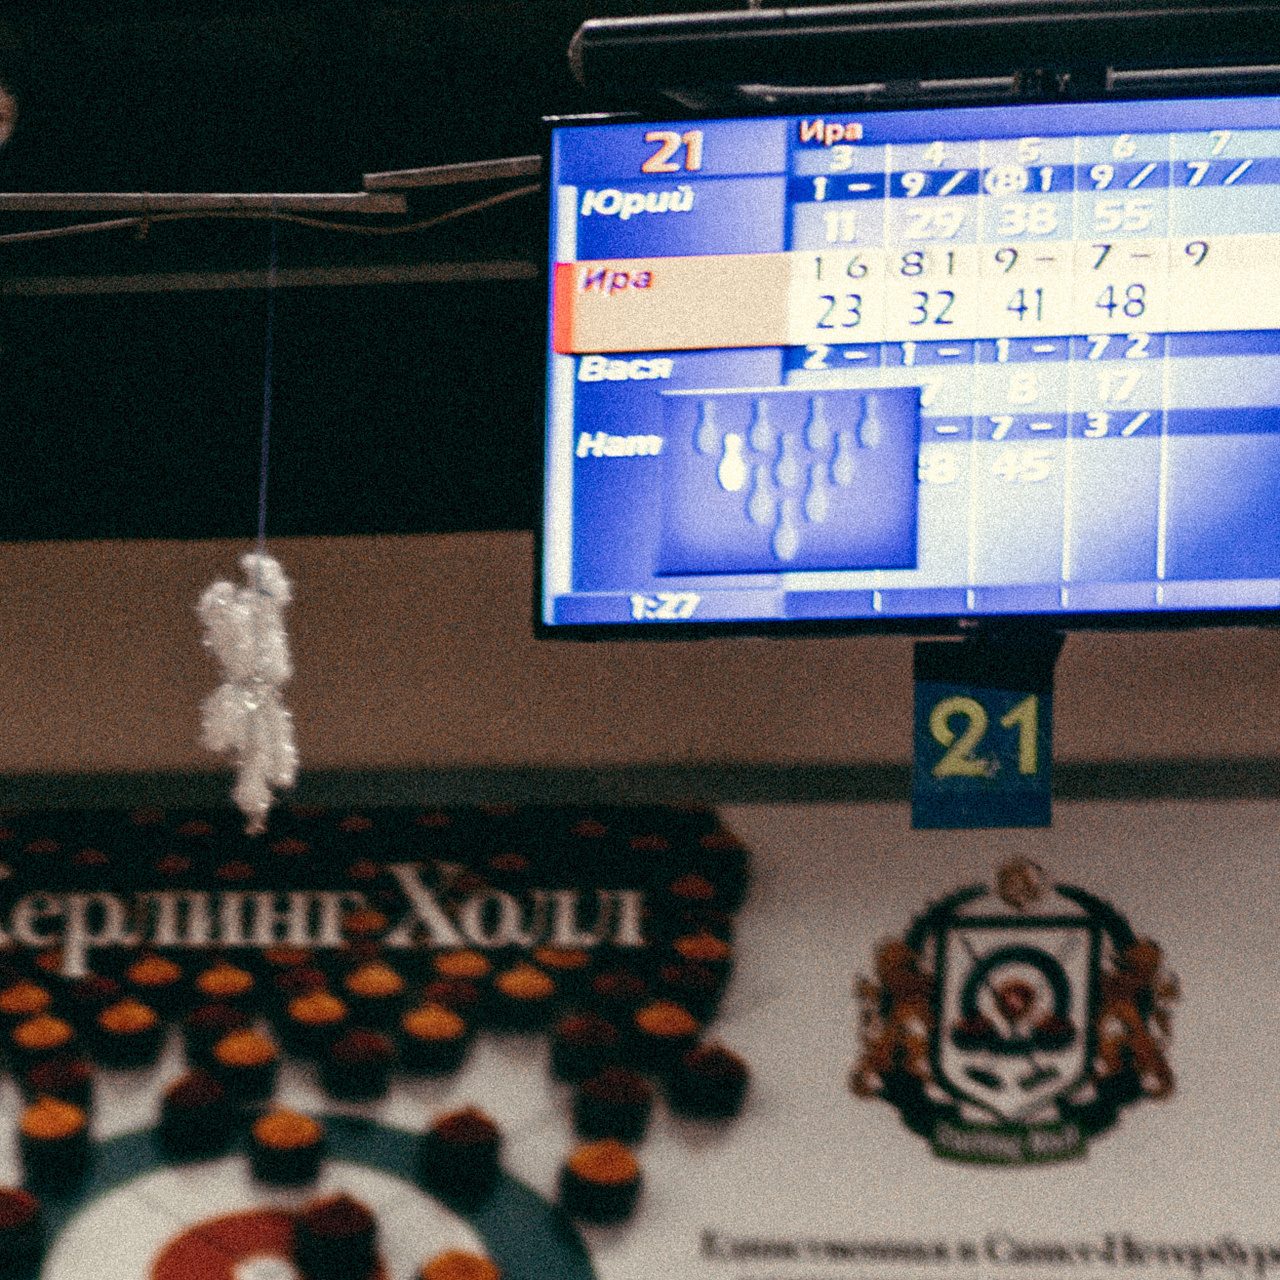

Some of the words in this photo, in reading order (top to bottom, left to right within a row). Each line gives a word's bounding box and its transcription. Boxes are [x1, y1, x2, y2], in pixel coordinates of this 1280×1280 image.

[641, 130, 704, 175] 21
[799, 119, 863, 147] Ира
[829, 145, 854, 171] 3
[922, 141, 947, 166] 4
[1019, 137, 1043, 161] 5
[1112, 134, 1137, 158] 6
[1209, 130, 1231, 156] 7
[580, 184, 695, 220] Юрий
[822, 210, 856, 242] 11
[997, 201, 1058, 237] 38
[1093, 199, 1153, 234] 55
[581, 269, 655, 297] Ира
[815, 293, 863, 330] 23
[908, 290, 956, 326] 32
[1006, 286, 1045, 322] 41
[1094, 282, 1147, 319] 48
[631, 592, 702, 620] 1:27
[928, 693, 1039, 778] 21
[383, 861, 646, 949] Холл
